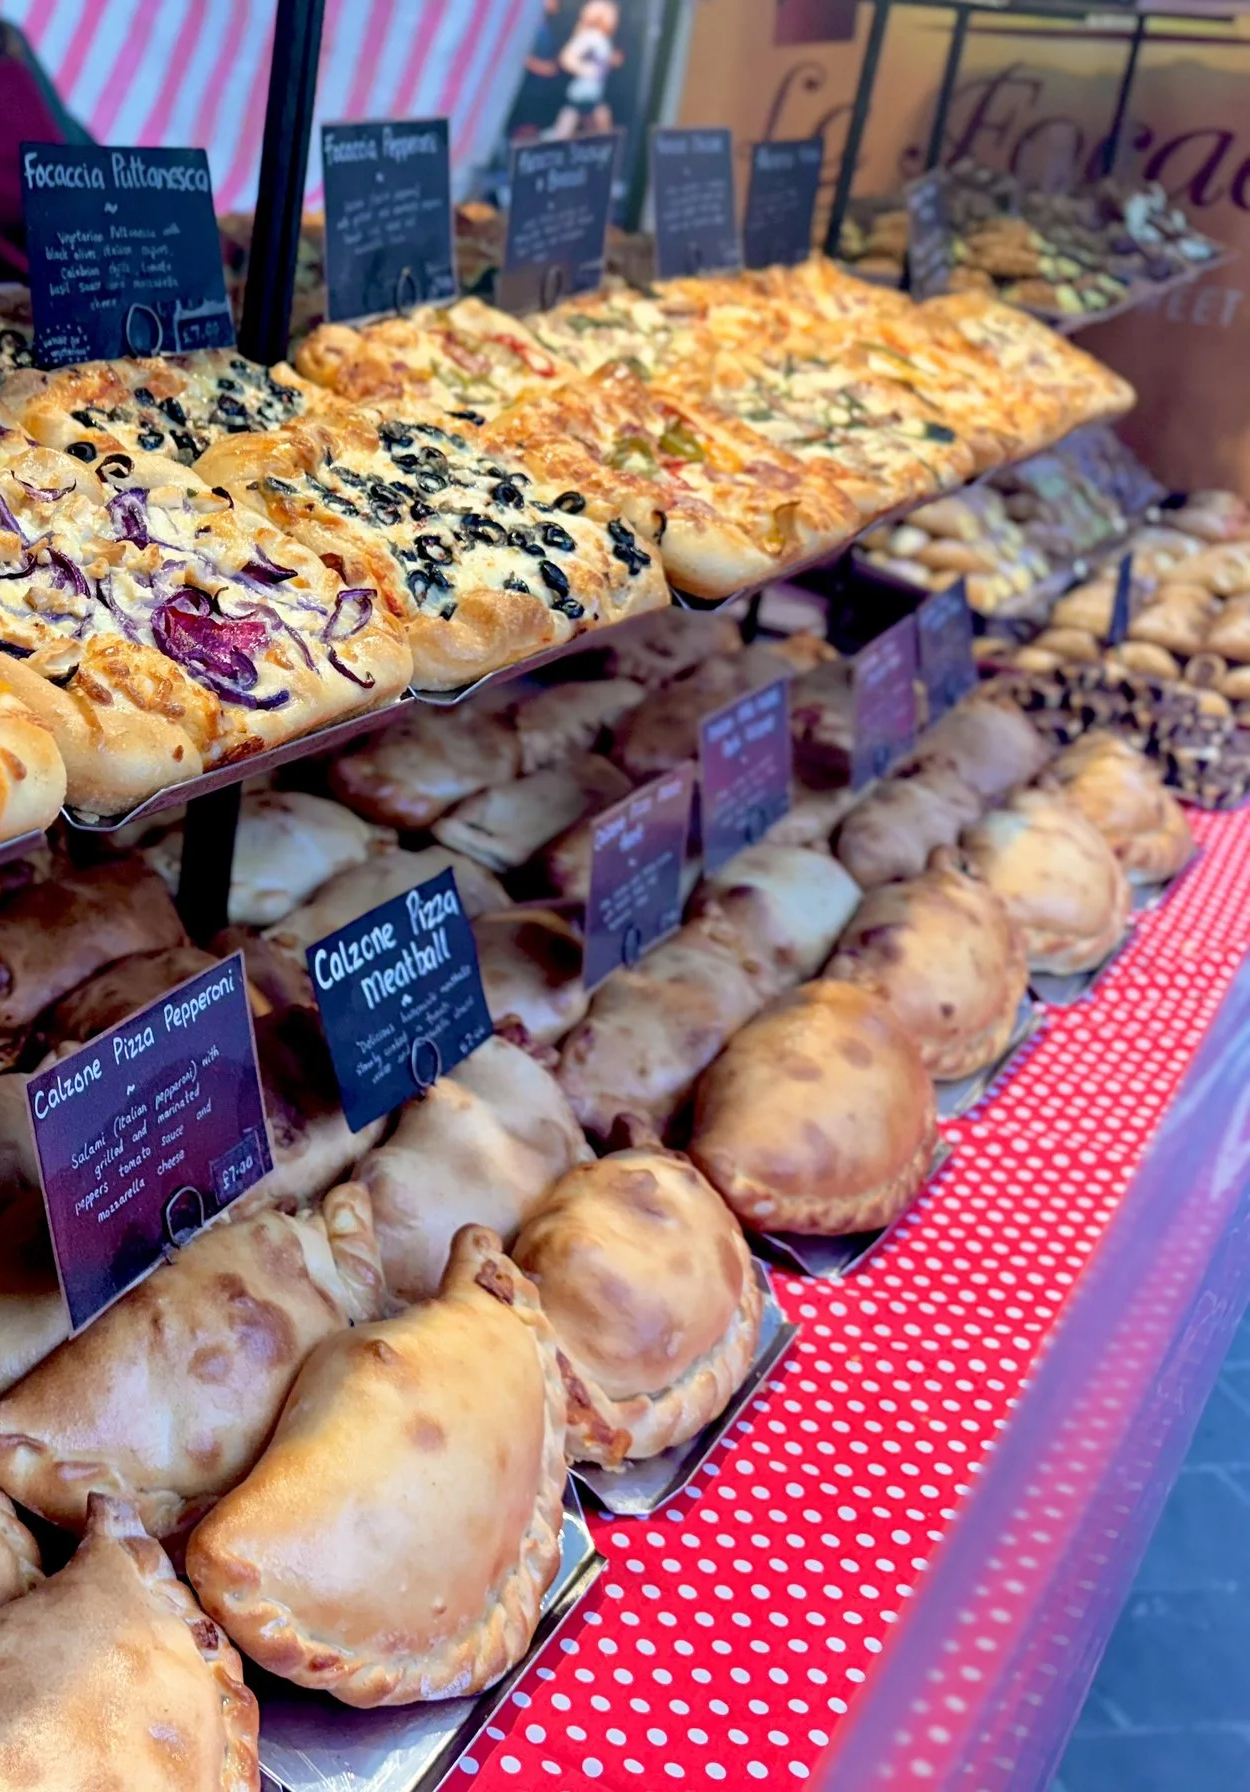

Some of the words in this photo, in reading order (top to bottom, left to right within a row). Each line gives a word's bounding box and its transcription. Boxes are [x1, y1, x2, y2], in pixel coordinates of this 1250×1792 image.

[24, 152, 105, 189] Focaccia
[111, 152, 208, 192] Puttanesca
[314, 922, 397, 991] Calzone
[406, 889, 459, 936] Pizza
[360, 927, 452, 1010] Meatball
[34, 1057, 102, 1120] Calzone
[113, 1026, 155, 1065] Pizza
[163, 970, 235, 1031] Pepperoni
[71, 1132, 106, 1170] Salami
[202, 1045, 220, 1067] with
[75, 1182, 109, 1216] peppers
[119, 1147, 151, 1177] tomato
[161, 1124, 184, 1146] sauce
[196, 1097, 212, 1120] and
[95, 1138, 124, 1180] grilled
[132, 1119, 147, 1142] and
[157, 1082, 200, 1124] marinated
[98, 1178, 145, 1223] mozzarella
[157, 1149, 185, 1175] cheese
[222, 1155, 253, 1190] £7.00
